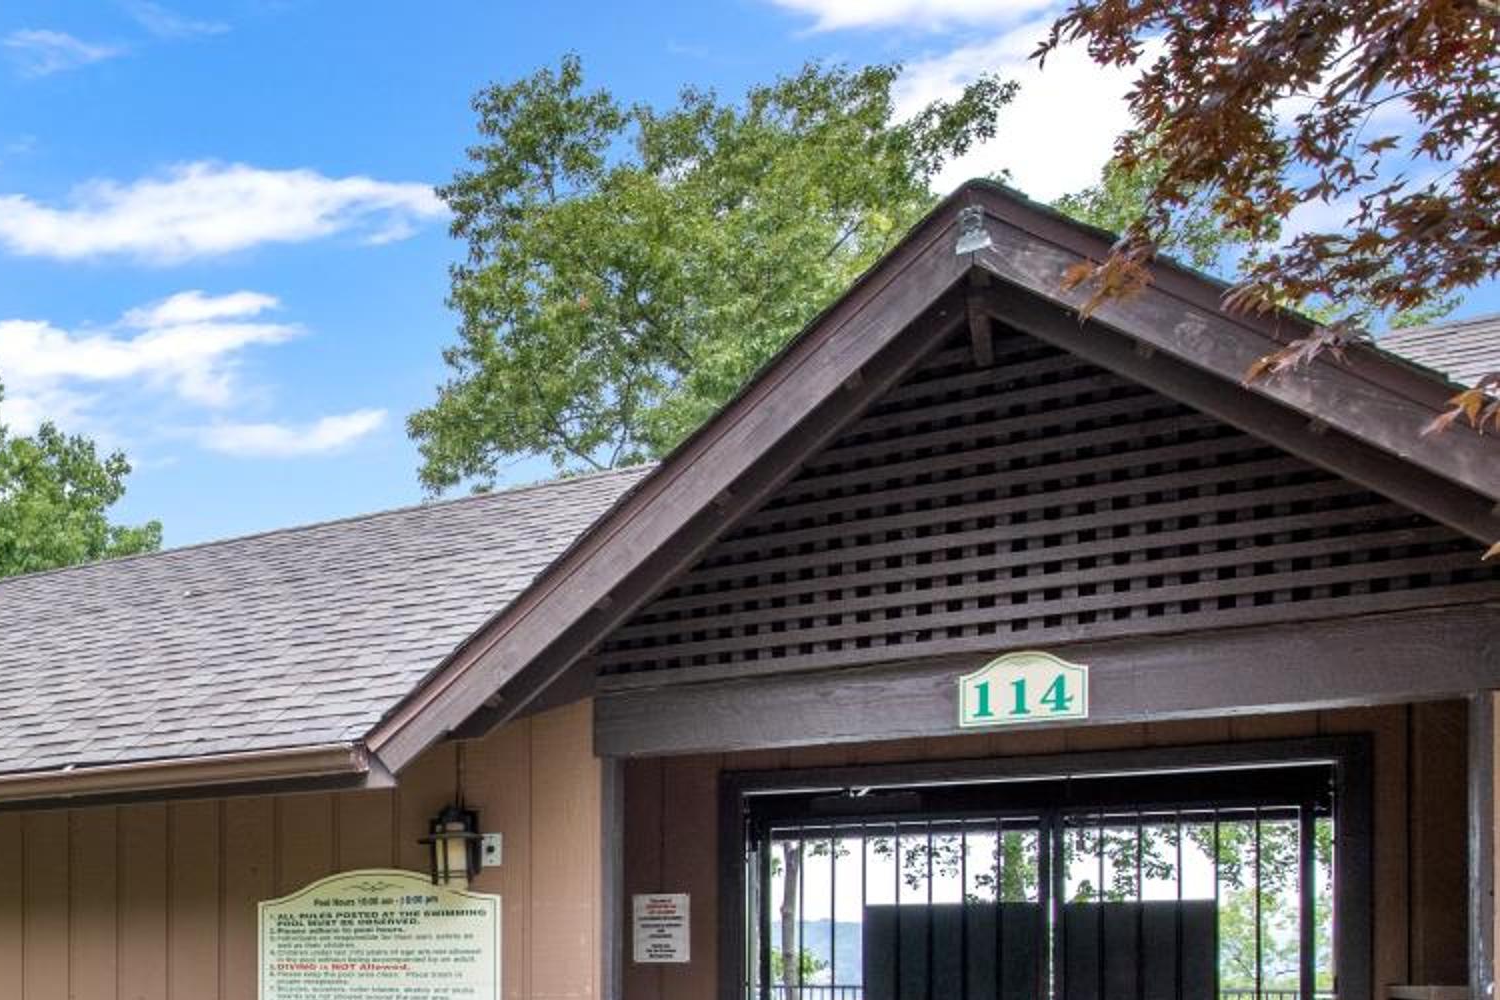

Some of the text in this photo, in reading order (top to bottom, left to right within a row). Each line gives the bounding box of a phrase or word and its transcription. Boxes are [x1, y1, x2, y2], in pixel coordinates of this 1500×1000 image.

[972, 674, 1074, 718] 114
[423, 909, 487, 917] SWIMMING
[357, 918, 420, 926] OBSERVED.
